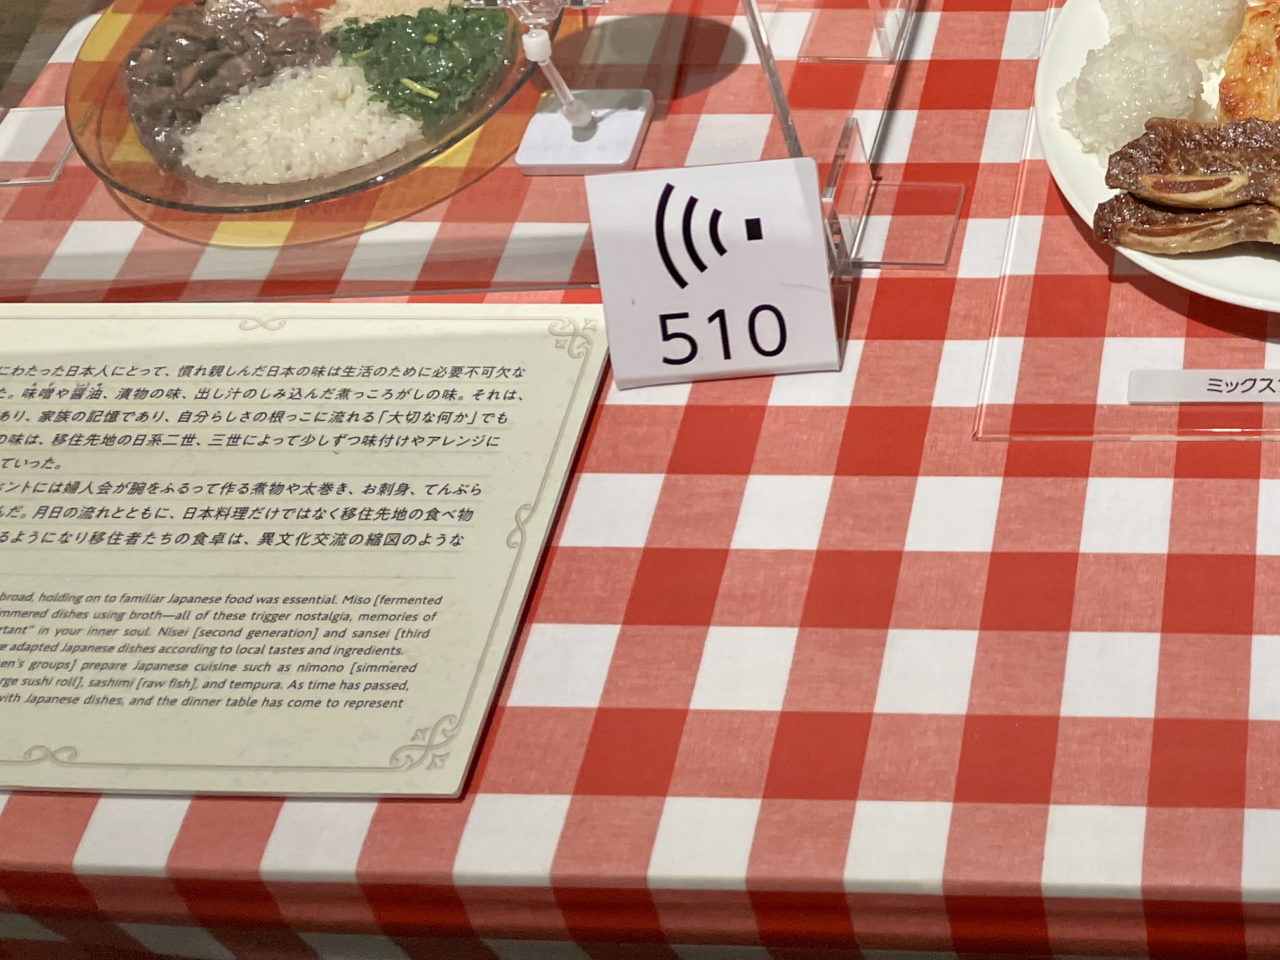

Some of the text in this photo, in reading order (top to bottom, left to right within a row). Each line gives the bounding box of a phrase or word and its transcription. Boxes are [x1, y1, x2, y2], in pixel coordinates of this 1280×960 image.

[658, 304, 788, 365] 510
[1, 456, 62, 470] ていった。
[39, 591, 83, 606] holding
[85, 594, 100, 603] on
[104, 593, 117, 603] to
[119, 592, 165, 604] familiar
[167, 592, 220, 607] Japanese
[224, 592, 252, 604] food
[256, 595, 279, 605] was
[282, 593, 338, 605] essential.
[342, 593, 370, 605] Miso
[373, 594, 443, 608] [fermented
[0, 607, 49, 619] mmered
[51, 607, 88, 619] dishes
[93, 608, 125, 623] using
[195, 609, 209, 621] of
[213, 609, 246, 621] these
[251, 609, 291, 624] trigger
[295, 610, 352, 625] nostalgia,
[358, 610, 418, 622] memories
[423, 610, 437, 622] of
[38, 624, 50, 636] in
[54, 627, 83, 639] your
[87, 625, 119, 637] inner
[158, 625, 189, 637] Nisei
[192, 625, 242, 639] [second
[246, 626, 319, 640] generation]
[323, 626, 346, 638] and
[352, 627, 390, 639] sansei
[394, 627, 430, 641] [third
[9, 640, 58, 655] adapted
[60, 641, 115, 656] Japanese
[117, 641, 155, 653] dishes
[158, 642, 216, 657] according
[219, 644, 233, 654] to
[235, 643, 265, 654] local
[268, 643, 304, 655] tastes
[307, 643, 330, 655] and
[333, 644, 404, 659] ingredients.
[28, 658, 76, 672] groups]
[80, 661, 128, 673] prepare
[132, 659, 189, 674] Japanese
[194, 659, 235, 671] cuisine
[243, 660, 271, 672] such
[277, 663, 291, 672] as
[297, 660, 344, 672] nimono
[350, 661, 418, 675] [simmered
[21, 675, 52, 687] sushi
[88, 676, 134, 688] sashimi
[136, 676, 168, 690] [raw
[202, 677, 227, 689] and
[229, 678, 283, 693] tempura.
[287, 678, 304, 690] As
[308, 678, 335, 690] time
[339, 679, 361, 691] has
[363, 679, 409, 694] passed,
[24, 692, 79, 707] Japanese
[129, 694, 152, 706] and
[156, 694, 177, 706] the
[181, 694, 220, 706] dinner
[225, 695, 258, 707] table
[262, 695, 283, 707] has
[287, 698, 322, 708] come
[326, 698, 340, 708] to
[343, 697, 404, 712] represent
